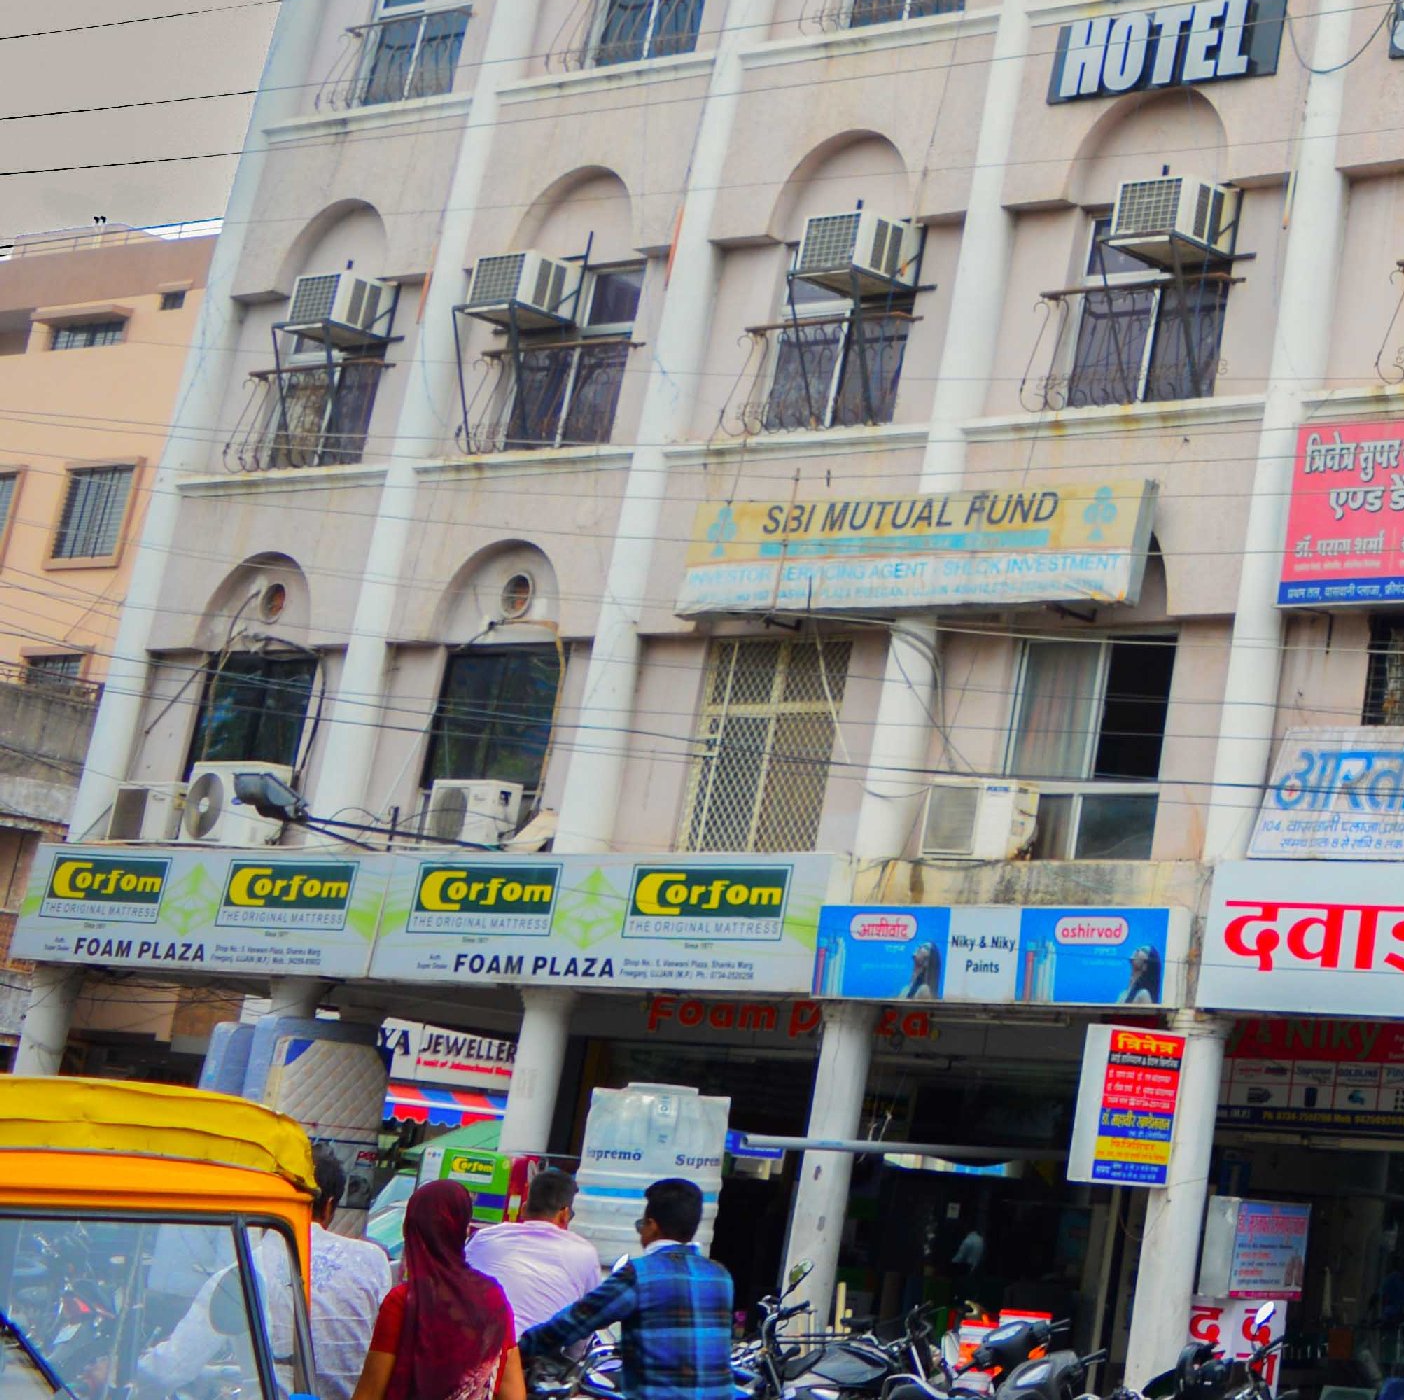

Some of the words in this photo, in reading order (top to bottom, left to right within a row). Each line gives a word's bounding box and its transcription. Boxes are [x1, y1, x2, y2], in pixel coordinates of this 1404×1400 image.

[1304, 430, 1358, 475] त्रिनेत्र
[1359, 439, 1402, 483] सुपर
[761, 502, 818, 536] SBI
[820, 497, 954, 534] MUTUAL
[964, 489, 1060, 527] FUND
[1329, 484, 1386, 521] एण्ड
[52, 860, 163, 900] Corfom
[228, 866, 349, 907] Corfom
[419, 870, 553, 911] Corfom
[635, 872, 783, 916] Corfom
[950, 934, 976, 953] Niky
[979, 935, 989, 948] &
[990, 936, 1017, 953] Niky
[1060, 921, 1124, 940] ashirvad
[73, 937, 134, 960] FOAM
[137, 941, 206, 964] PLAZA
[453, 953, 526, 976] FOAM
[531, 955, 616, 979] PLAZA
[964, 958, 1001, 975] Paints
[647, 994, 777, 1033] Foam
